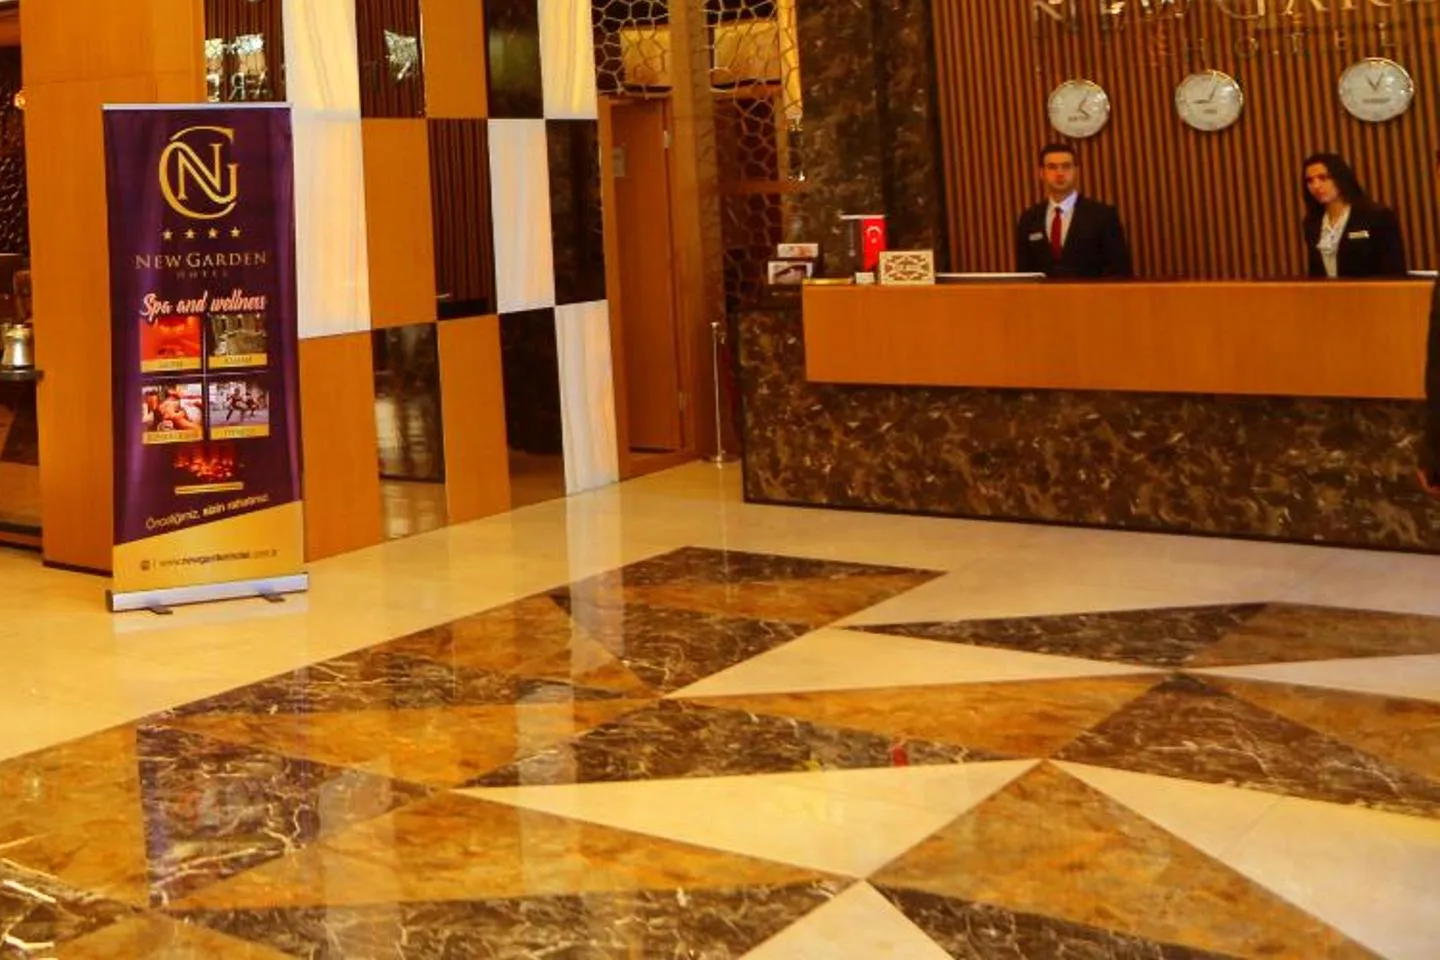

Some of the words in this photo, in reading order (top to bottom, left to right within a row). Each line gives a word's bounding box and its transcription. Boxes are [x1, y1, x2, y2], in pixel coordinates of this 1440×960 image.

[186, 251, 266, 268] GARDEN
[139, 292, 174, 322] Spa
[176, 289, 208, 314] and
[210, 287, 267, 313] wellness
